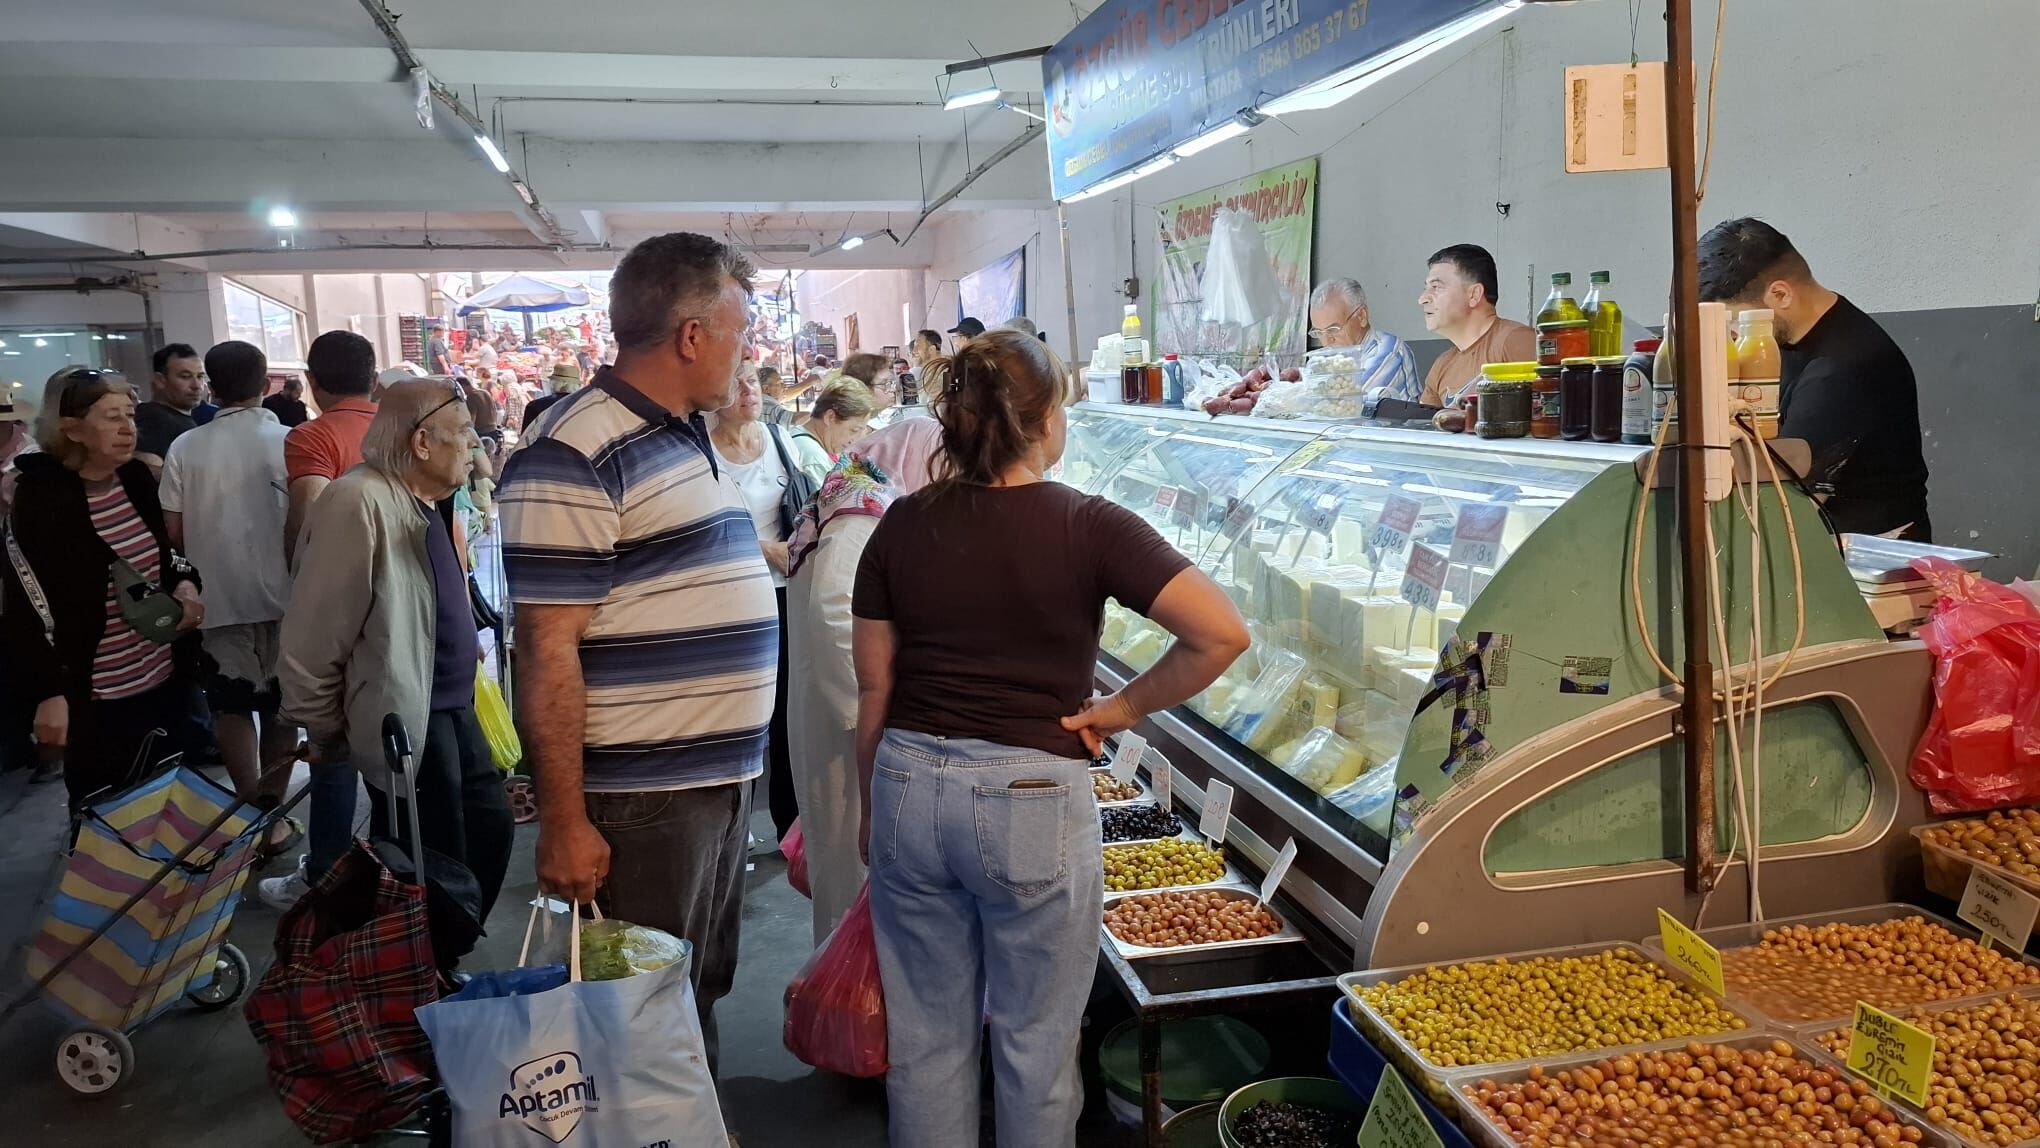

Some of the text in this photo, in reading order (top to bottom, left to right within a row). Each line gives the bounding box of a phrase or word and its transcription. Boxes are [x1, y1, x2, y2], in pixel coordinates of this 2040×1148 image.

[1259, 40, 1291, 77] 0543
[1294, 23, 1321, 60] 865
[1324, 9, 1344, 44] 37
[1347, 0, 1369, 31] 67
[560, 1106, 584, 1118] Devam
